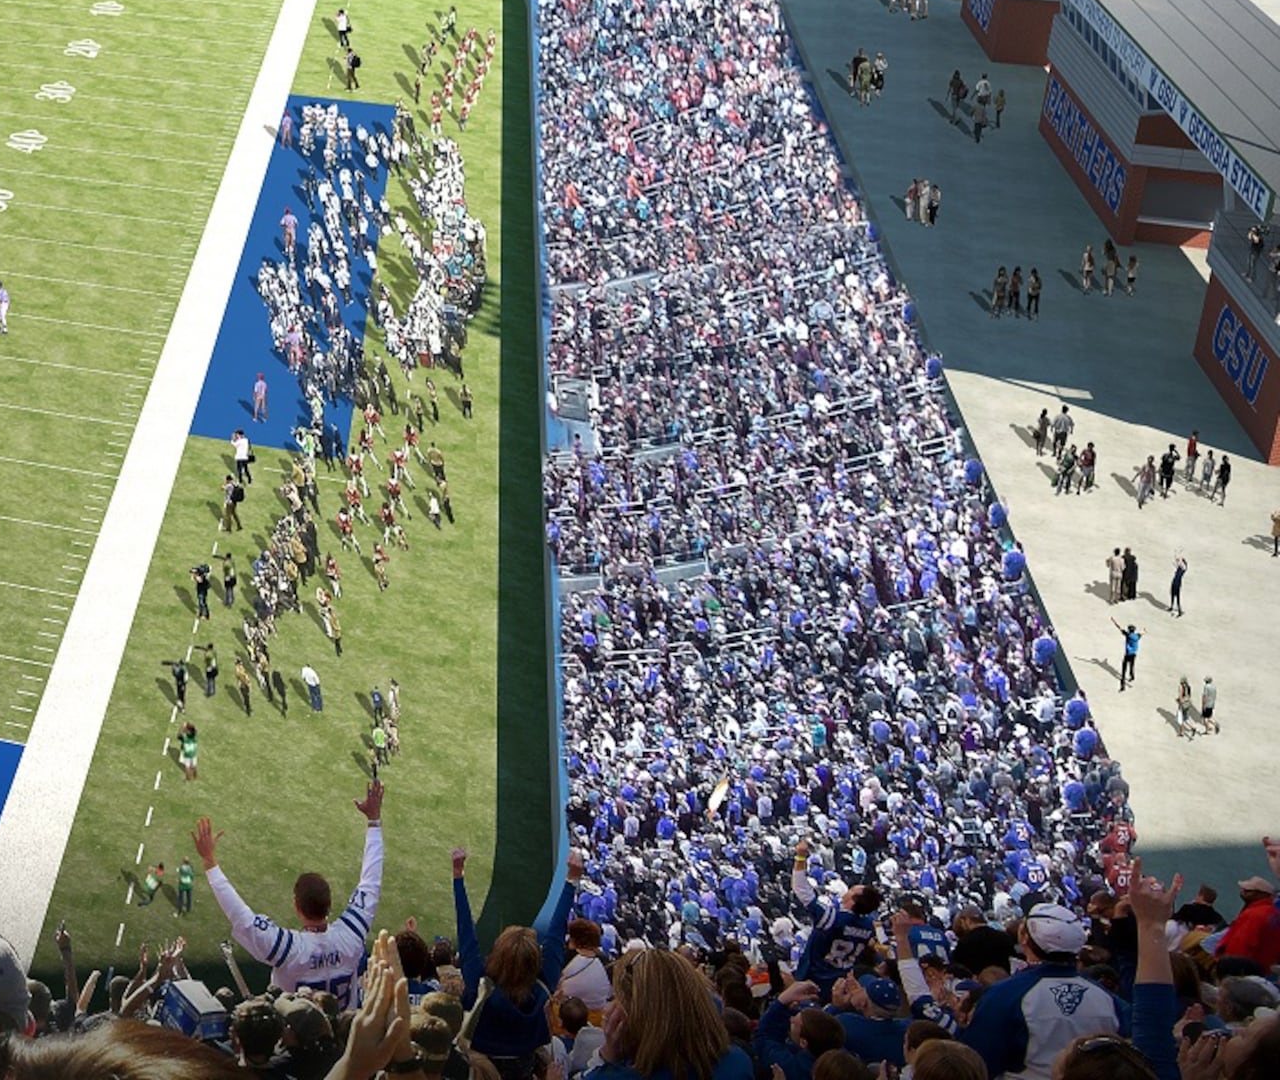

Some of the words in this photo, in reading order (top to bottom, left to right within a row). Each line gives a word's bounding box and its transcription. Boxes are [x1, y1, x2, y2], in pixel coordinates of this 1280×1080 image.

[1043, 76, 1127, 217] PANTHERS
[1158, 79, 1178, 112] GSU
[1189, 112, 1230, 177] GEORGIA
[1231, 159, 1266, 213] STATE
[1212, 303, 1270, 406] GSU
